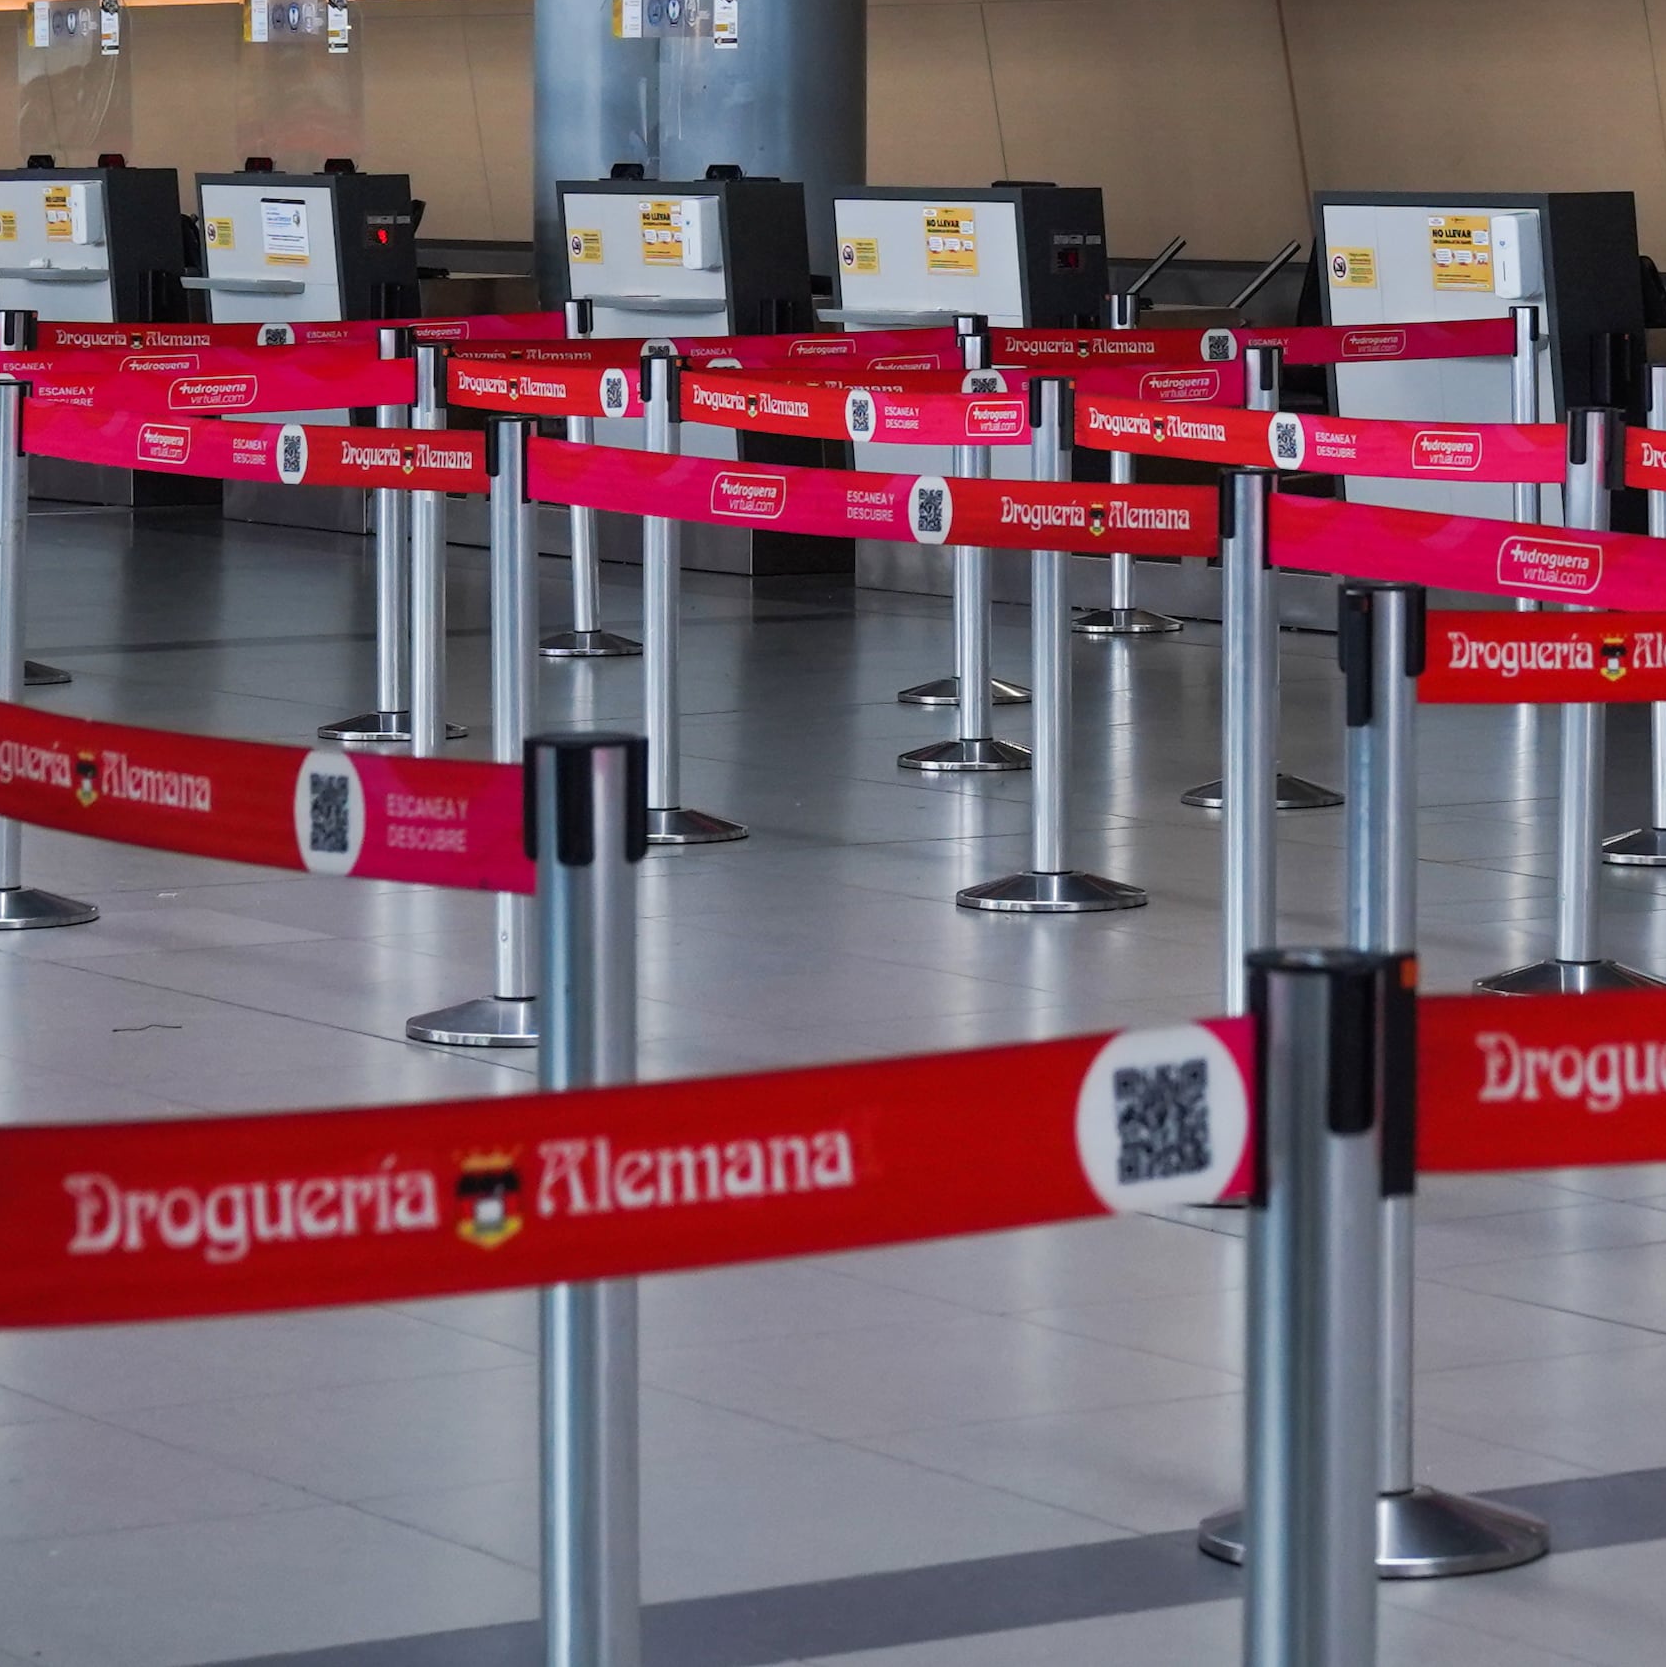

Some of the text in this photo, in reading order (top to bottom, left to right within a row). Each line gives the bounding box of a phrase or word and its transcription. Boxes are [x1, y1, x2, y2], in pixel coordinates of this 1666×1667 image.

[692, 384, 809, 418] Droguería Alemana
[1089, 411, 1226, 442] Droguería Alemana
[341, 439, 473, 471] Droguería Alemana
[1000, 496, 1190, 531] Droguería Alemana
[1448, 631, 1594, 677] Droguería
[101, 748, 211, 811] Alemana
[387, 792, 451, 821] ESCANEA
[387, 824, 468, 853] DESCUBRE
[63, 1129, 855, 1263] Droguería Alemana
